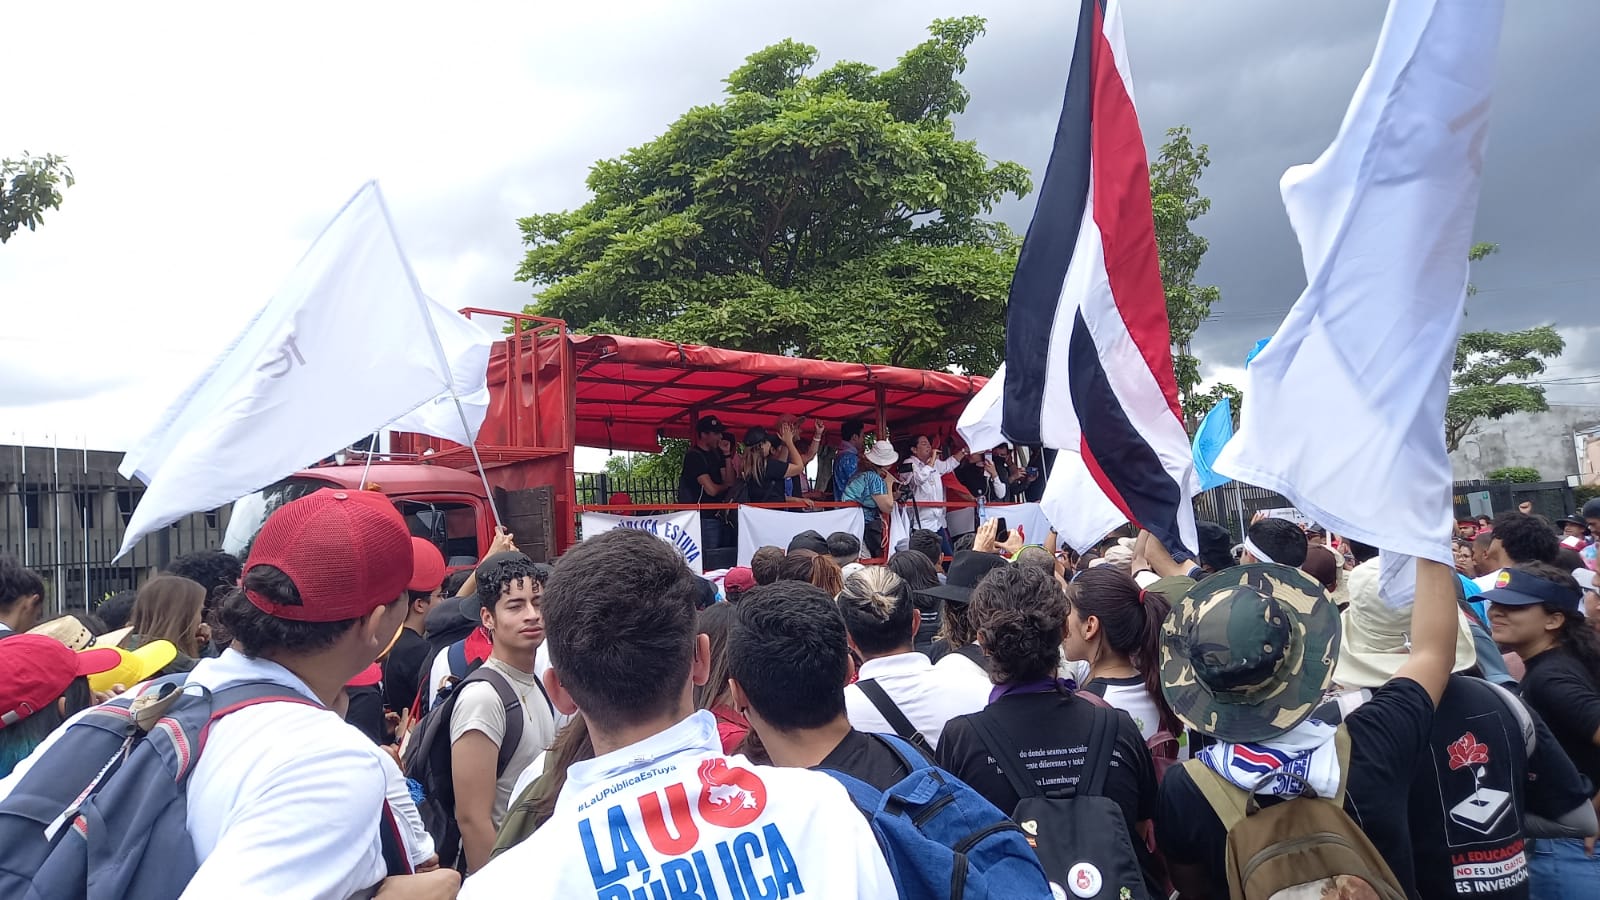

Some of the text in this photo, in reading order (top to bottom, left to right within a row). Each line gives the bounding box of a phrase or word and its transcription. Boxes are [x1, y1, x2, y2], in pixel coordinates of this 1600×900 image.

[1028, 748, 1046, 757] donde
[1046, 748, 1068, 756] seamos
[1039, 759, 1067, 769] diferentes
[578, 764, 677, 812] #LaUPúblicaEsTuya
[578, 782, 699, 890] LA U
[1452, 853, 1465, 865] LA
[1456, 867, 1472, 876] NO
[1474, 867, 1486, 876] ES
[1488, 866, 1503, 875] UN
[1455, 881, 1472, 893] ES
